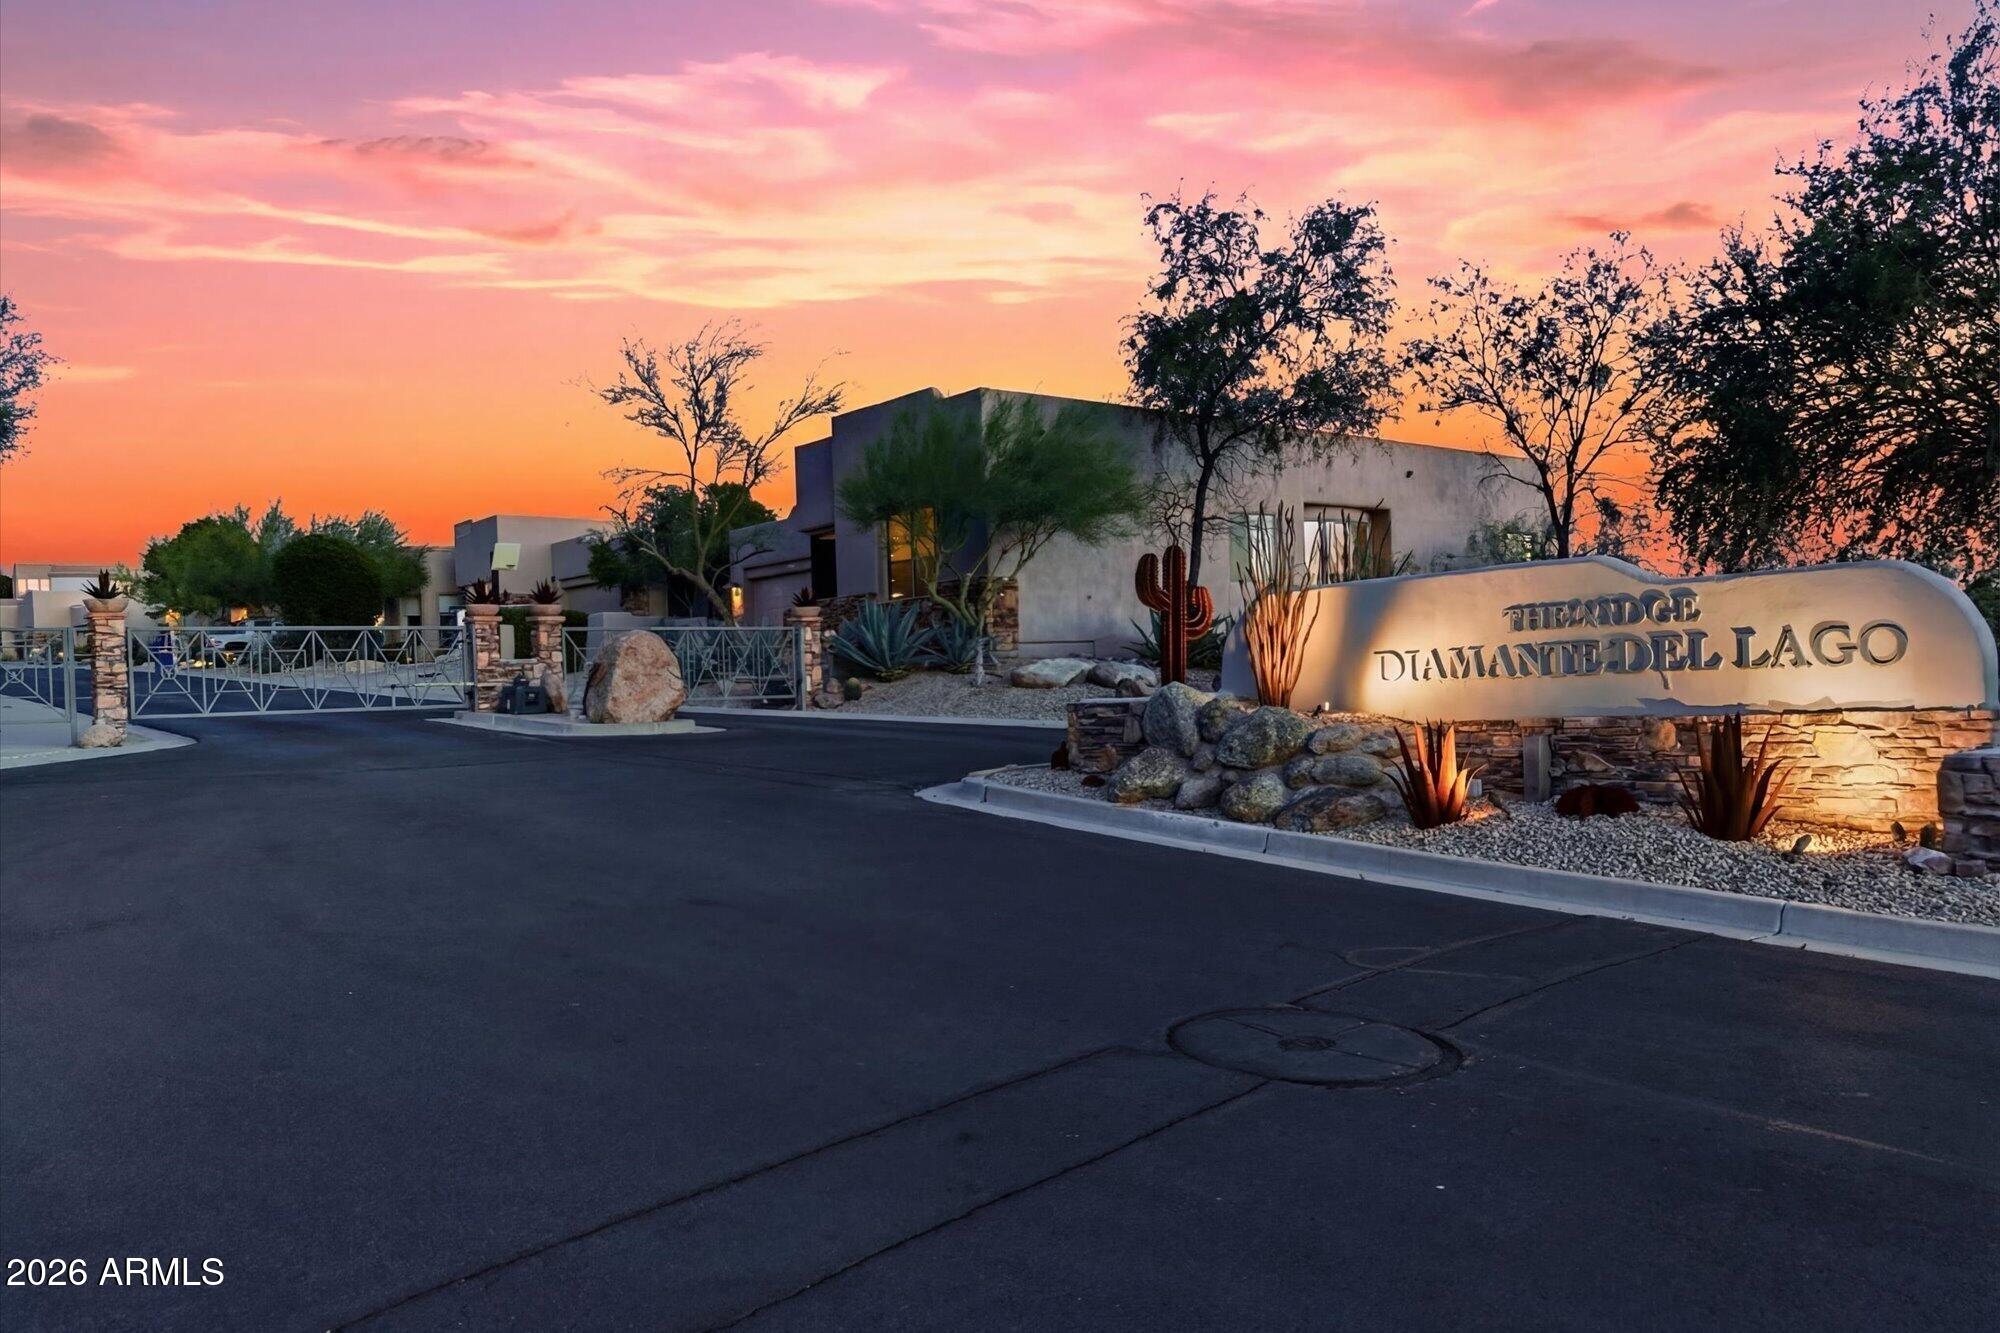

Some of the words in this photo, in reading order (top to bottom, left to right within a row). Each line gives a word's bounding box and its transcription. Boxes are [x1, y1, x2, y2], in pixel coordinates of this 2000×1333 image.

[1504, 602, 1569, 633] THE
[1374, 638, 1601, 683] DIAMANTE
[1605, 629, 1722, 675] DEL
[1731, 621, 1907, 669] LAGO
